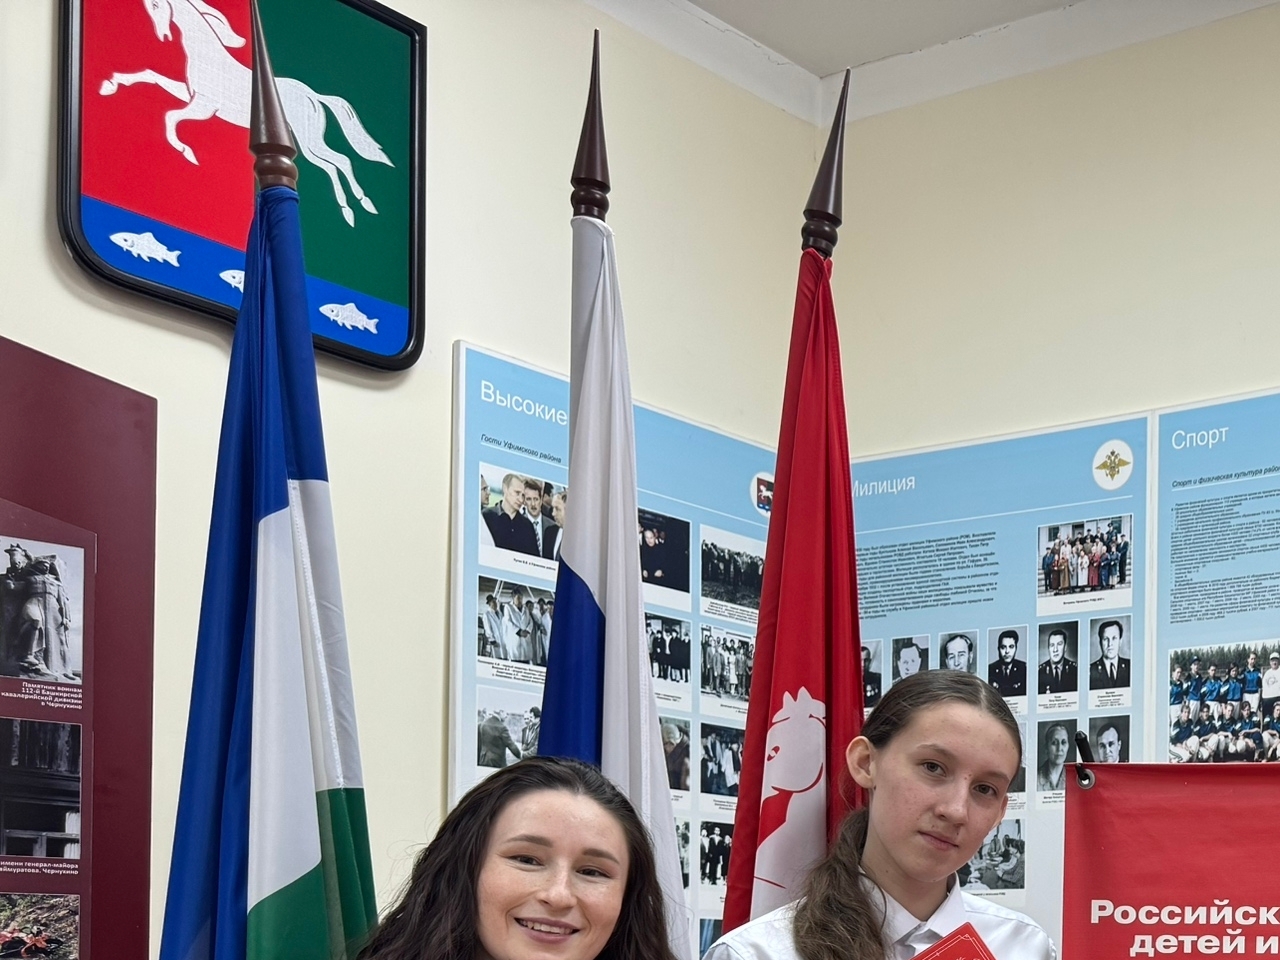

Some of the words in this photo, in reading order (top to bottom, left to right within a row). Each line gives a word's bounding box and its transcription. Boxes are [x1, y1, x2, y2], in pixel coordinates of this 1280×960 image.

[480, 379, 568, 425] Высокие
[480, 433, 503, 447] Гости
[503, 440, 539, 457] Уфимского
[539, 451, 562, 464] района
[1171, 426, 1230, 450] Спорт
[851, 475, 916, 498] Милиция
[1171, 478, 1193, 489] Спорт
[1197, 471, 1233, 485] физическая
[1233, 466, 1263, 479] культура
[24, 861, 79, 869] генерал-майора
[1129, 929, 1246, 958] детей
[1255, 935, 1280, 955] и
